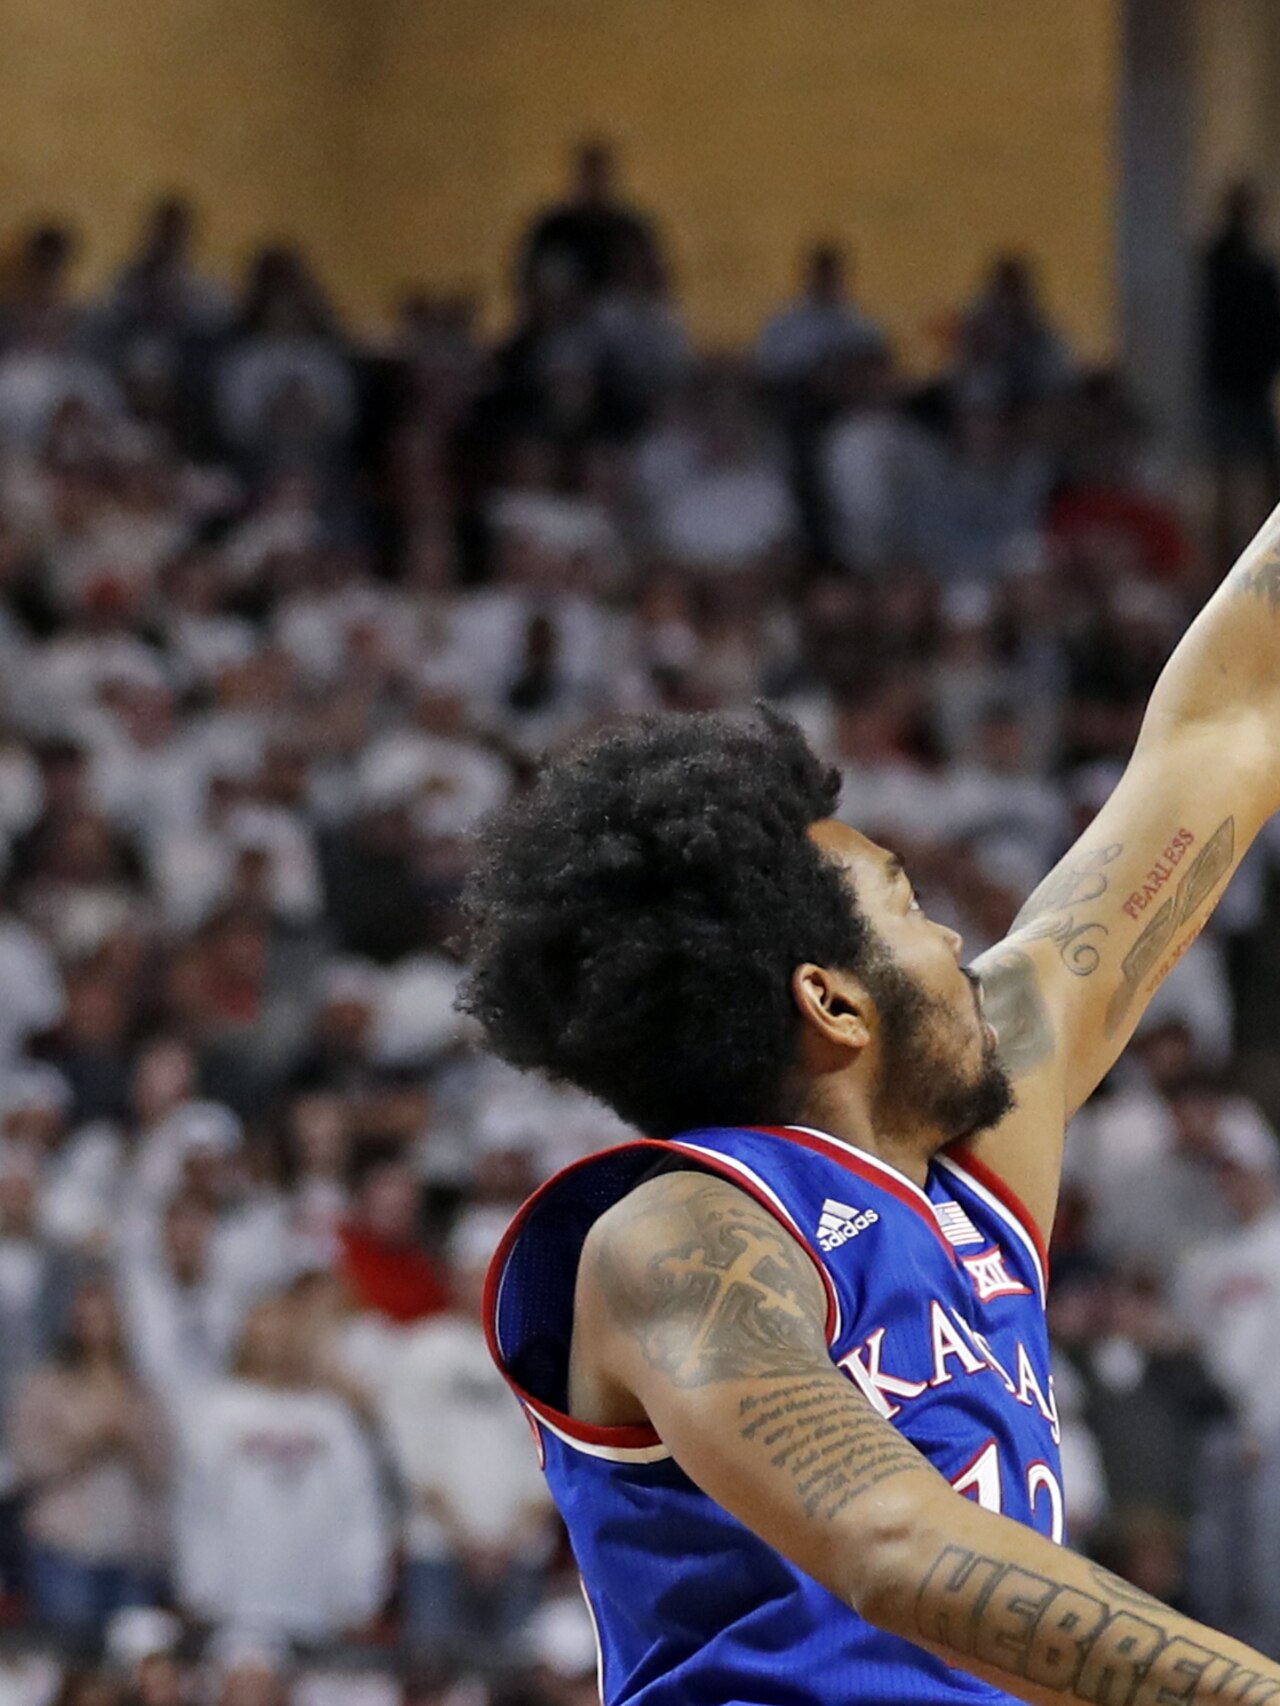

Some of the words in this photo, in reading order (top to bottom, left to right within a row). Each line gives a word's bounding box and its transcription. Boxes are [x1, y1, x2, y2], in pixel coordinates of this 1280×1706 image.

[1121, 828, 1195, 920] FEARLESS
[819, 1208, 879, 1252] adidas
[837, 1299, 1061, 1446] KASAS
